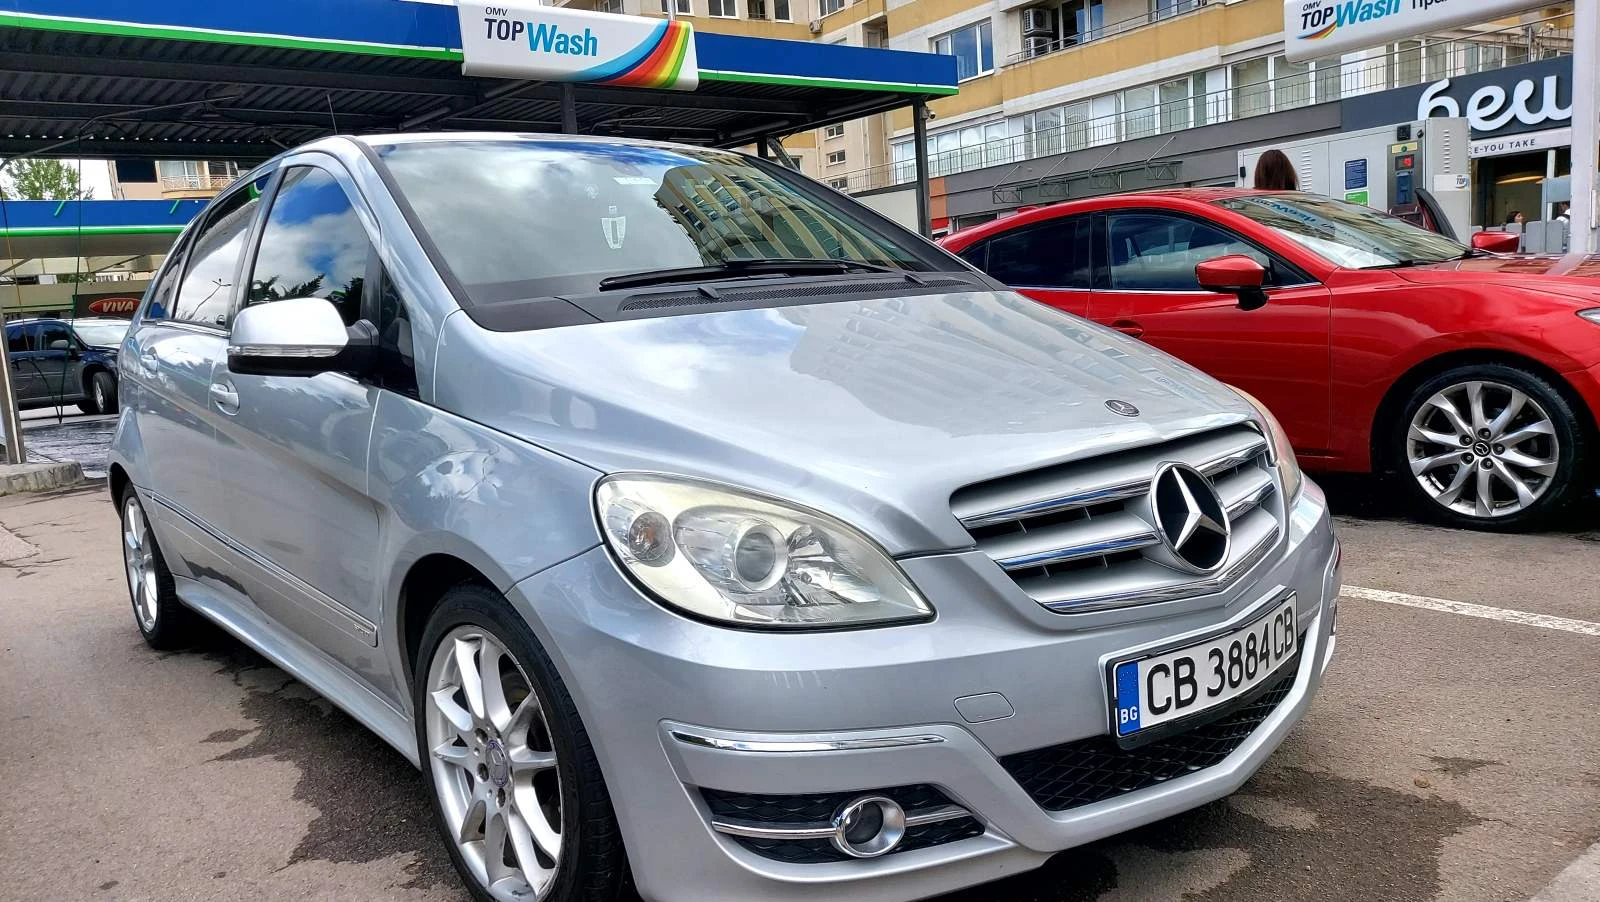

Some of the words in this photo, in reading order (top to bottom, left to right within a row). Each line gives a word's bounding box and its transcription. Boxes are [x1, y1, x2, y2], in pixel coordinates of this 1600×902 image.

[485, 6, 508, 17] OMV
[1303, 1, 1321, 11] OMV
[1510, 139, 1536, 149] TAKE
[102, 301, 134, 312] VIVA
[1147, 656, 1198, 716] CB
[1207, 623, 1270, 697] 3884
[1273, 606, 1294, 660] CB
[1120, 706, 1138, 724] BG
